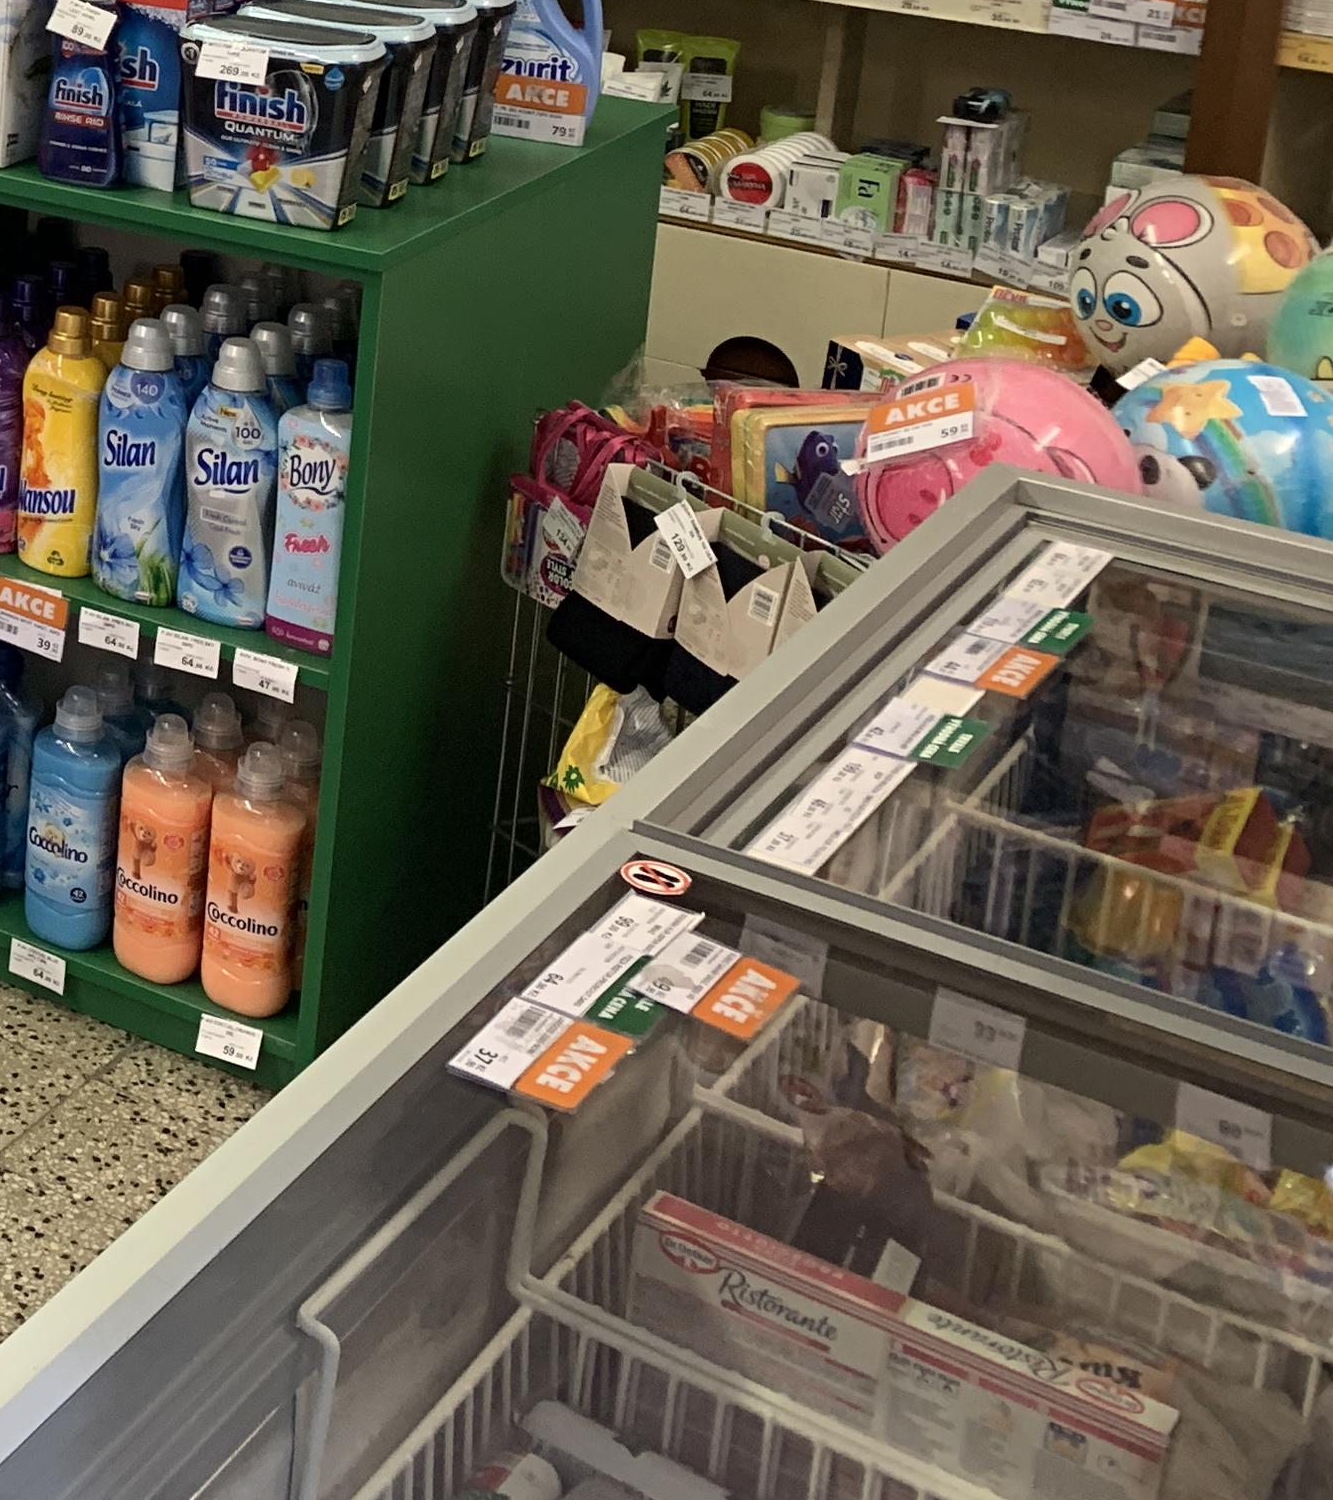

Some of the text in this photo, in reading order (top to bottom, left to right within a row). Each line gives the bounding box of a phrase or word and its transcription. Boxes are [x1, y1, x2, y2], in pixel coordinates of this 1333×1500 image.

[502, 58, 572, 76] zurit
[54, 78, 104, 108] finish
[215, 81, 307, 127] finish
[505, 83, 569, 108] AKCE
[55, 113, 104, 127] RINSE AID
[224, 122, 295, 142] QUANTUM
[135, 382, 158, 397] 140
[104, 429, 156, 467] Silan
[235, 427, 261, 440] 100
[194, 448, 259, 485] Silan
[290, 454, 336, 487] Bony
[284, 532, 331, 554] Fresh
[28, 825, 89, 866] Coccolino
[116, 866, 179, 906] Coccolino
[207, 901, 279, 938] Coccolino
[717, 1271, 840, 1343] Ristorante
